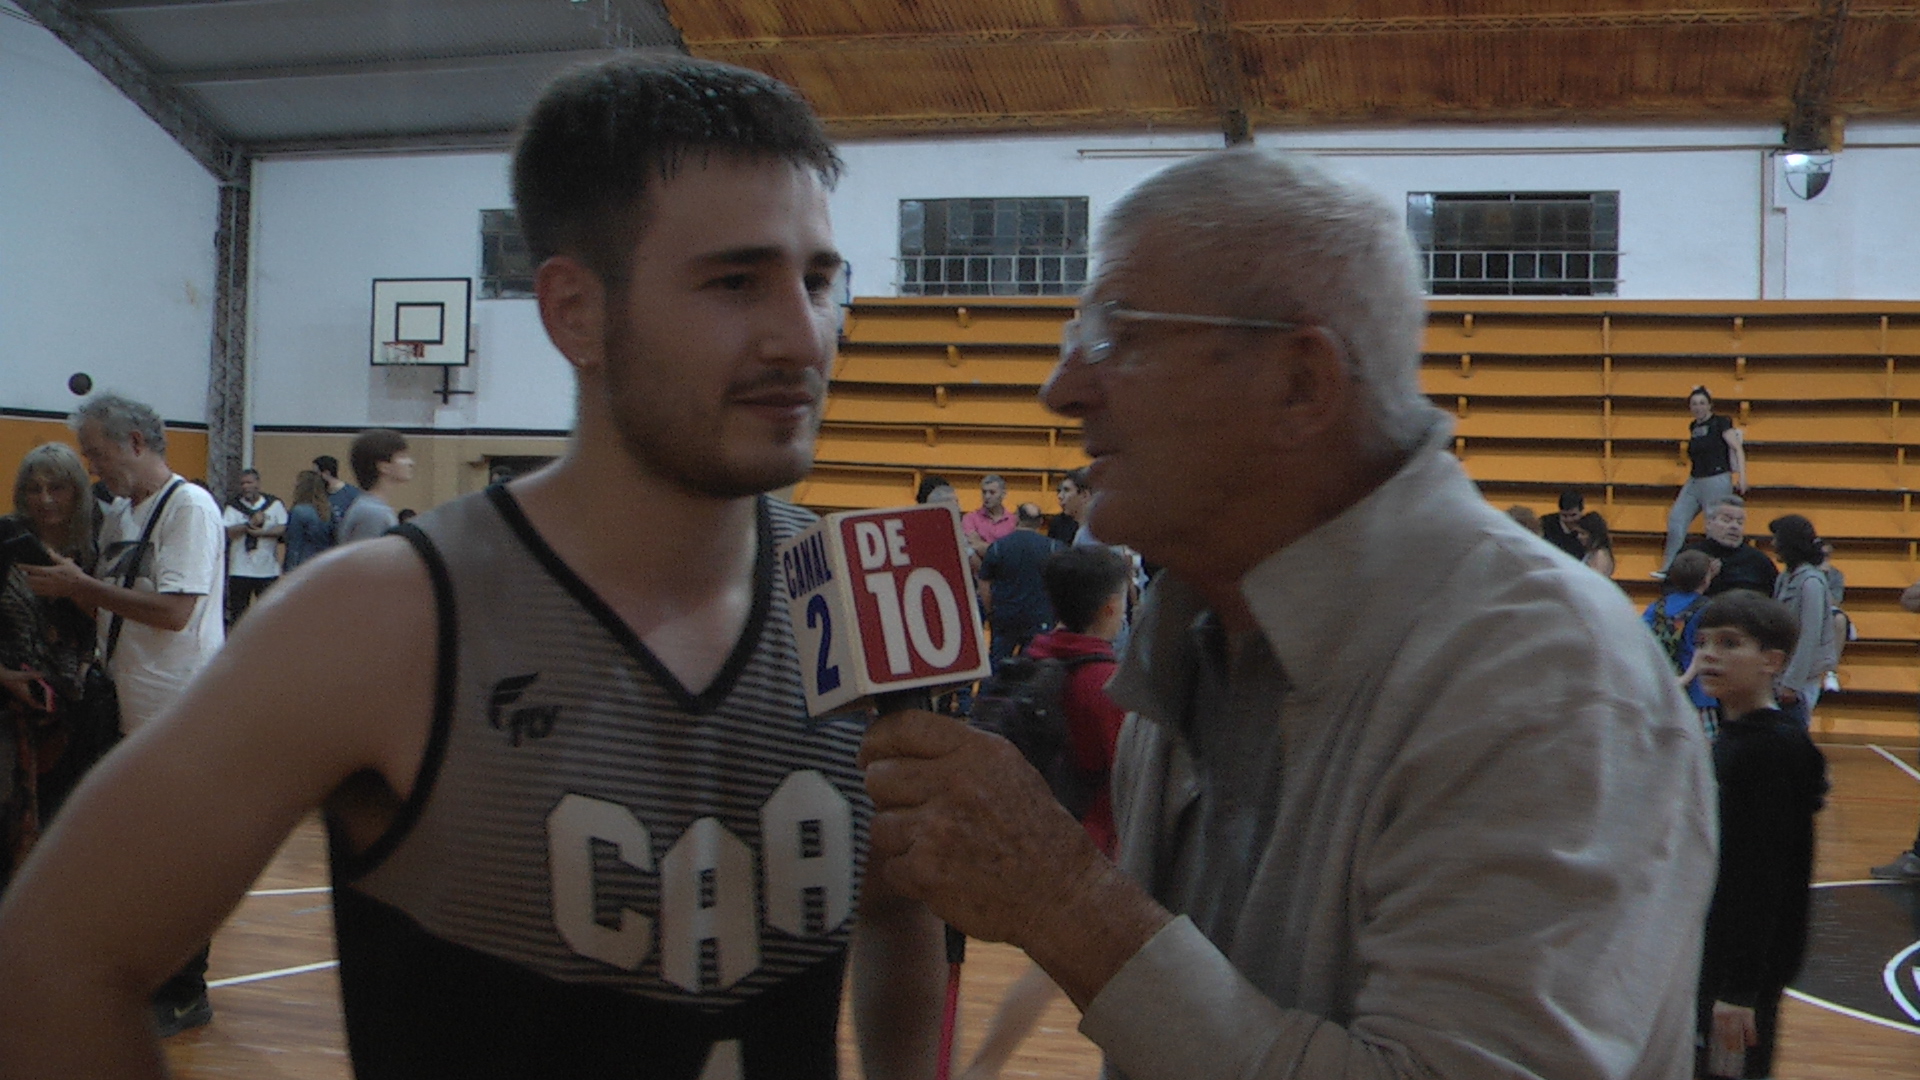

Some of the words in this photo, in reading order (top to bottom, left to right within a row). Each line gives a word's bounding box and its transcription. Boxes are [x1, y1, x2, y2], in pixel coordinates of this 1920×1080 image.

[783, 530, 833, 600] CANAL
[854, 518, 911, 571] DE
[806, 593, 841, 696] 2
[864, 566, 962, 676] 10
[545, 769, 853, 994] CAA
